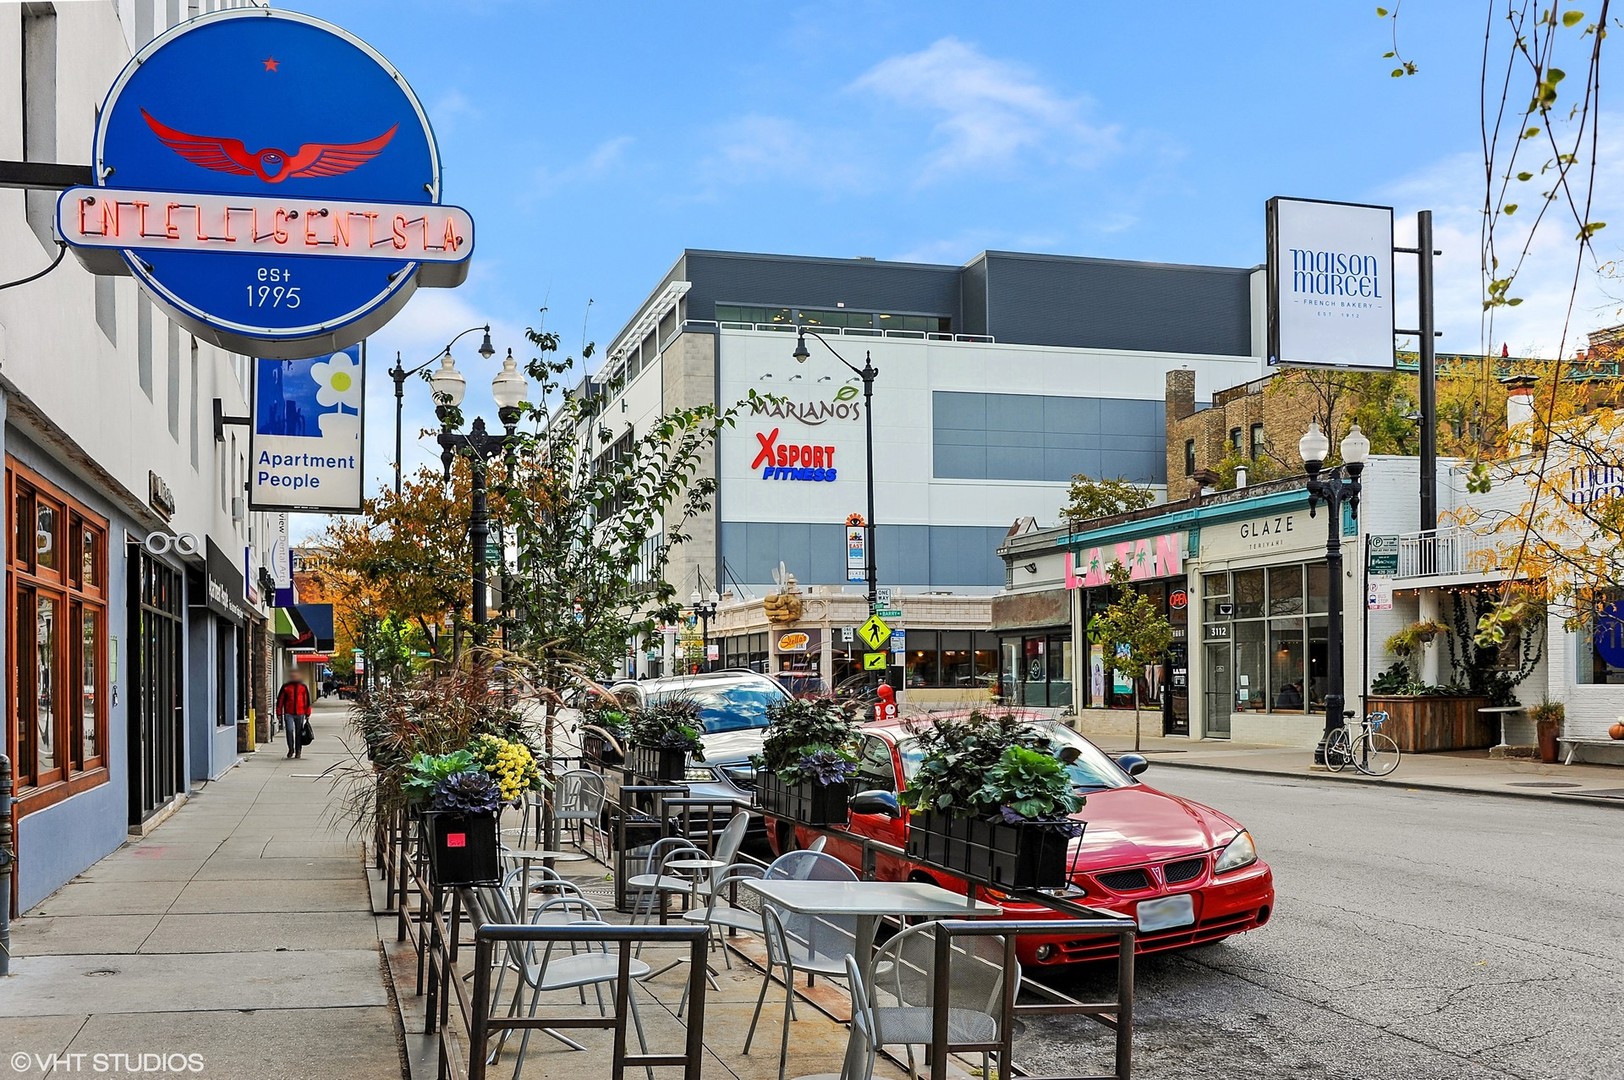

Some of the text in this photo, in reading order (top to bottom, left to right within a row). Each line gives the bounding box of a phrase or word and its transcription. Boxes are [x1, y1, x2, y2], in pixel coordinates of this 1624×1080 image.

[78, 198, 459, 251] INTELLIGENTSIA
[257, 267, 291, 282] est
[247, 285, 301, 308] 1995
[1303, 299, 1336, 307] FRENCH
[750, 398, 860, 426] MARIANO'S
[751, 427, 835, 470] XSPORT
[258, 450, 355, 469] Apartment
[258, 471, 320, 490] People
[762, 466, 838, 482] FITNESS
[1240, 516, 1293, 538] GLAZE
[279, 535, 287, 565] Dental
[1249, 540, 1283, 550] TERIYAKI
[279, 566, 287, 582] Arts
[1211, 627, 1227, 636] 3112
